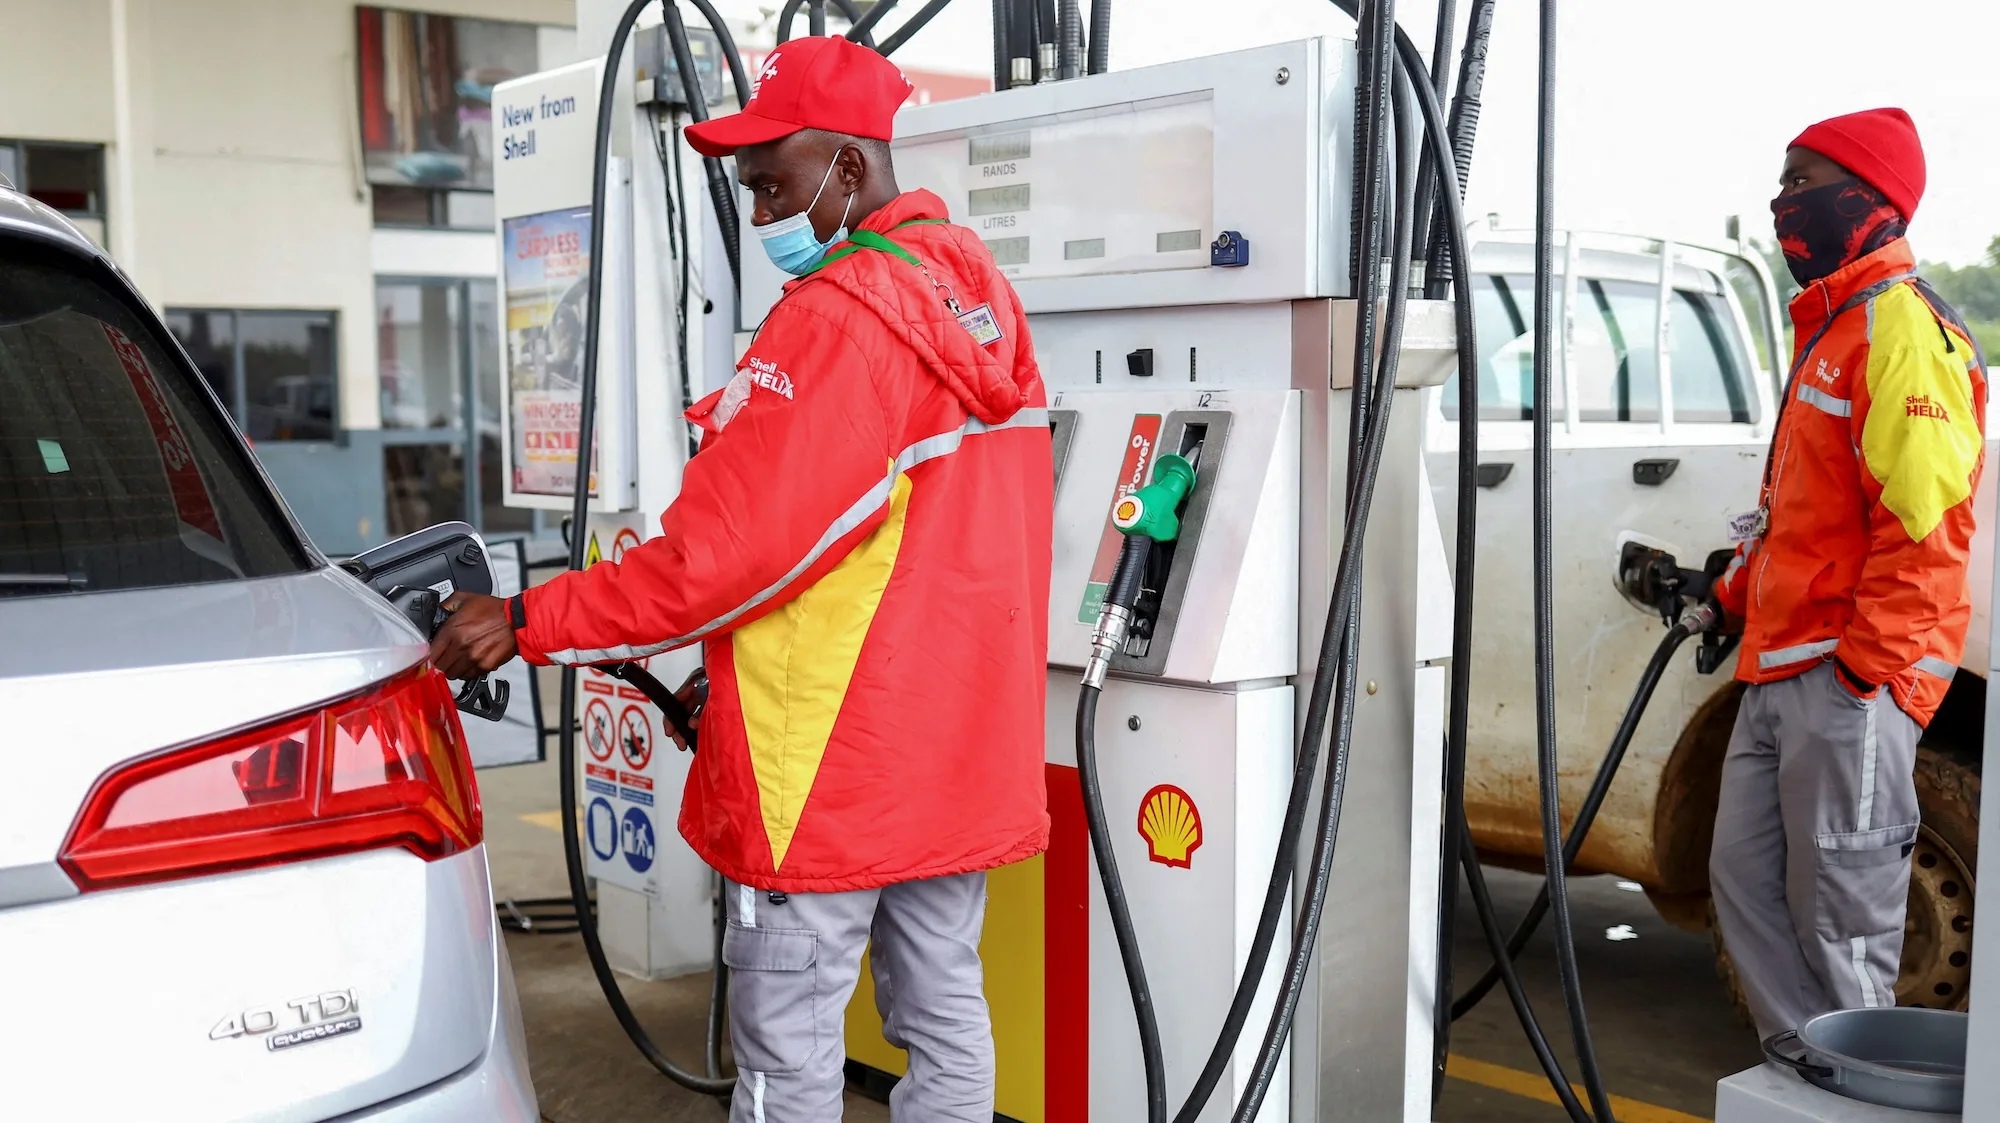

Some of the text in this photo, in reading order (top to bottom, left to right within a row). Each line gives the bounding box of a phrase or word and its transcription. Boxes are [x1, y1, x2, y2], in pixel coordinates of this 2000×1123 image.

[503, 95, 576, 128] New from
[503, 130, 536, 160] Shell
[983, 163, 1017, 177] RANDS
[983, 215, 1017, 229] LITRES
[749, 356, 777, 374] Shell
[751, 369, 795, 400] HELIX
[1198, 393, 1212, 407] 12
[1905, 394, 1929, 405] Shell
[1905, 404, 1951, 423] HELIX
[1128, 438, 1150, 494] Power
[1335, 741, 1345, 783] FUTURA
[1321, 840, 1330, 869] Continental
[1314, 875, 1323, 901] ContiTech
[1290, 951, 1305, 991] FUTURA
[209, 986, 359, 1040] 40 TDI
[268, 1016, 362, 1051] quattro
[1262, 1046, 1276, 1076] Continental
[1250, 1081, 1263, 1107] ContiTech
